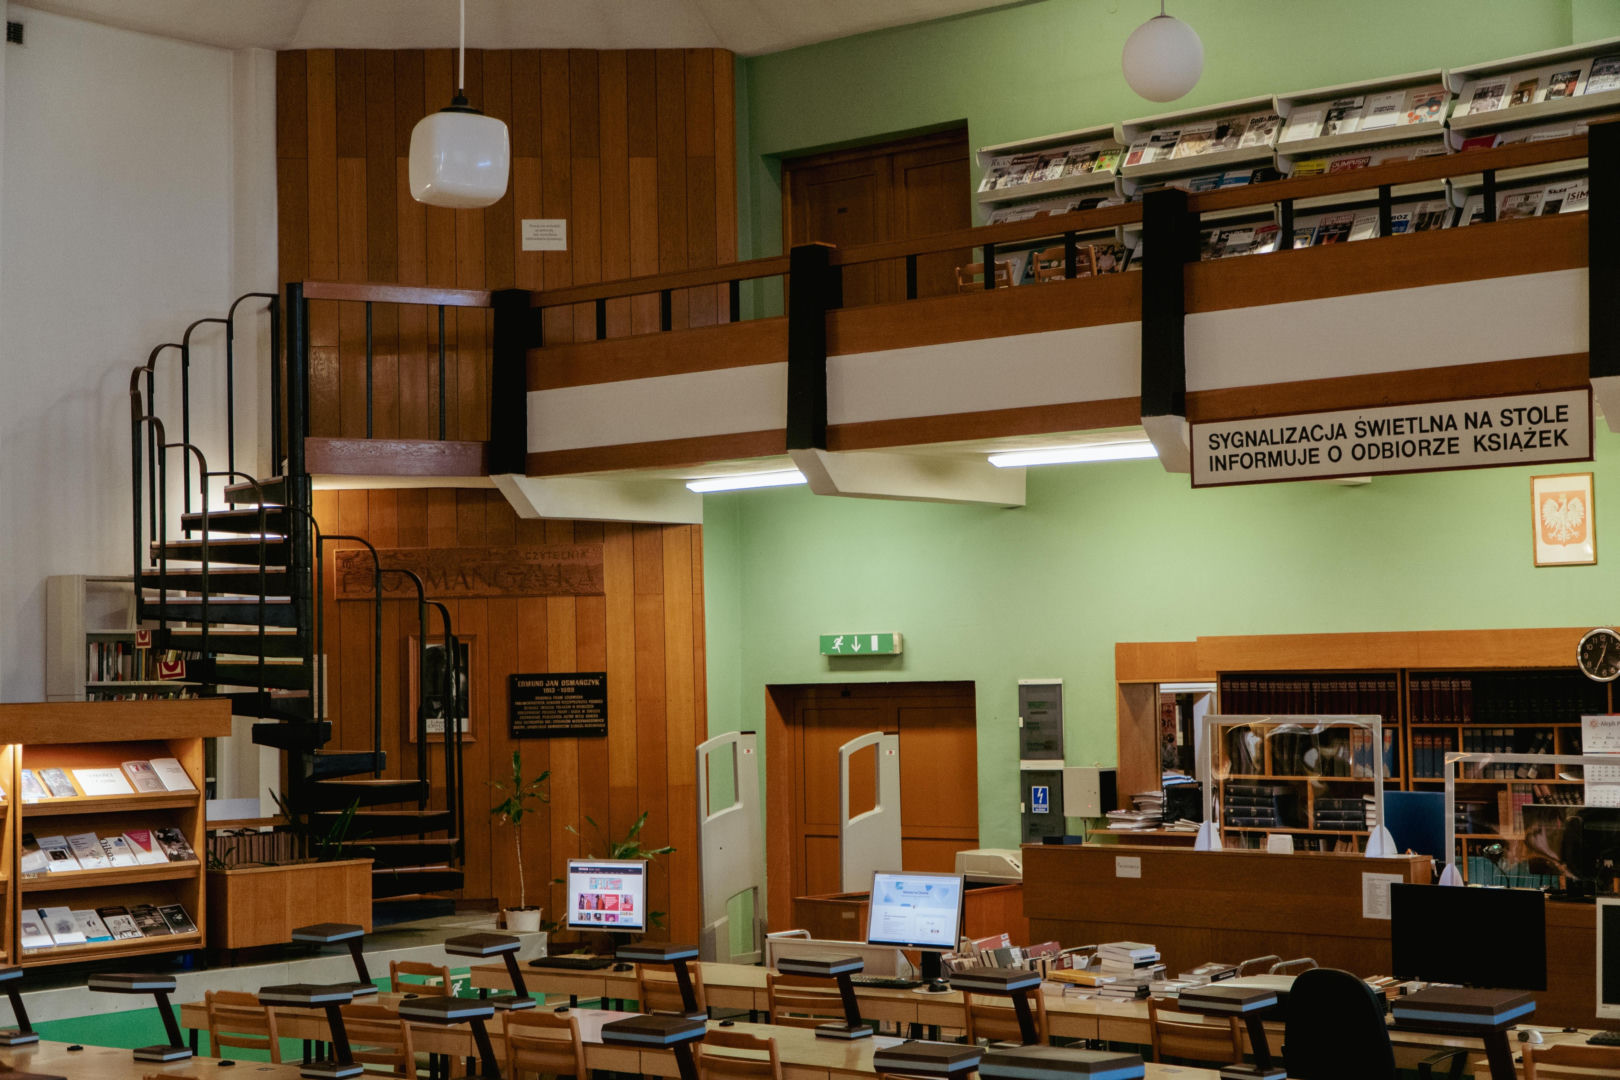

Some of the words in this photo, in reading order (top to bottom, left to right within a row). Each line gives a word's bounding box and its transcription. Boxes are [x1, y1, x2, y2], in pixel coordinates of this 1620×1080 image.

[1208, 423, 1347, 450] SYGNALIZACJA
[1354, 413, 1458, 439] ŚWIETLNA
[1464, 410, 1494, 430] NA
[1500, 404, 1569, 428] STOLE
[1209, 447, 1321, 472] INFORMUJE
[1327, 445, 1343, 462] O
[1351, 437, 1460, 462] ODBIORZE
[1473, 428, 1569, 454] KSIĄŻEK
